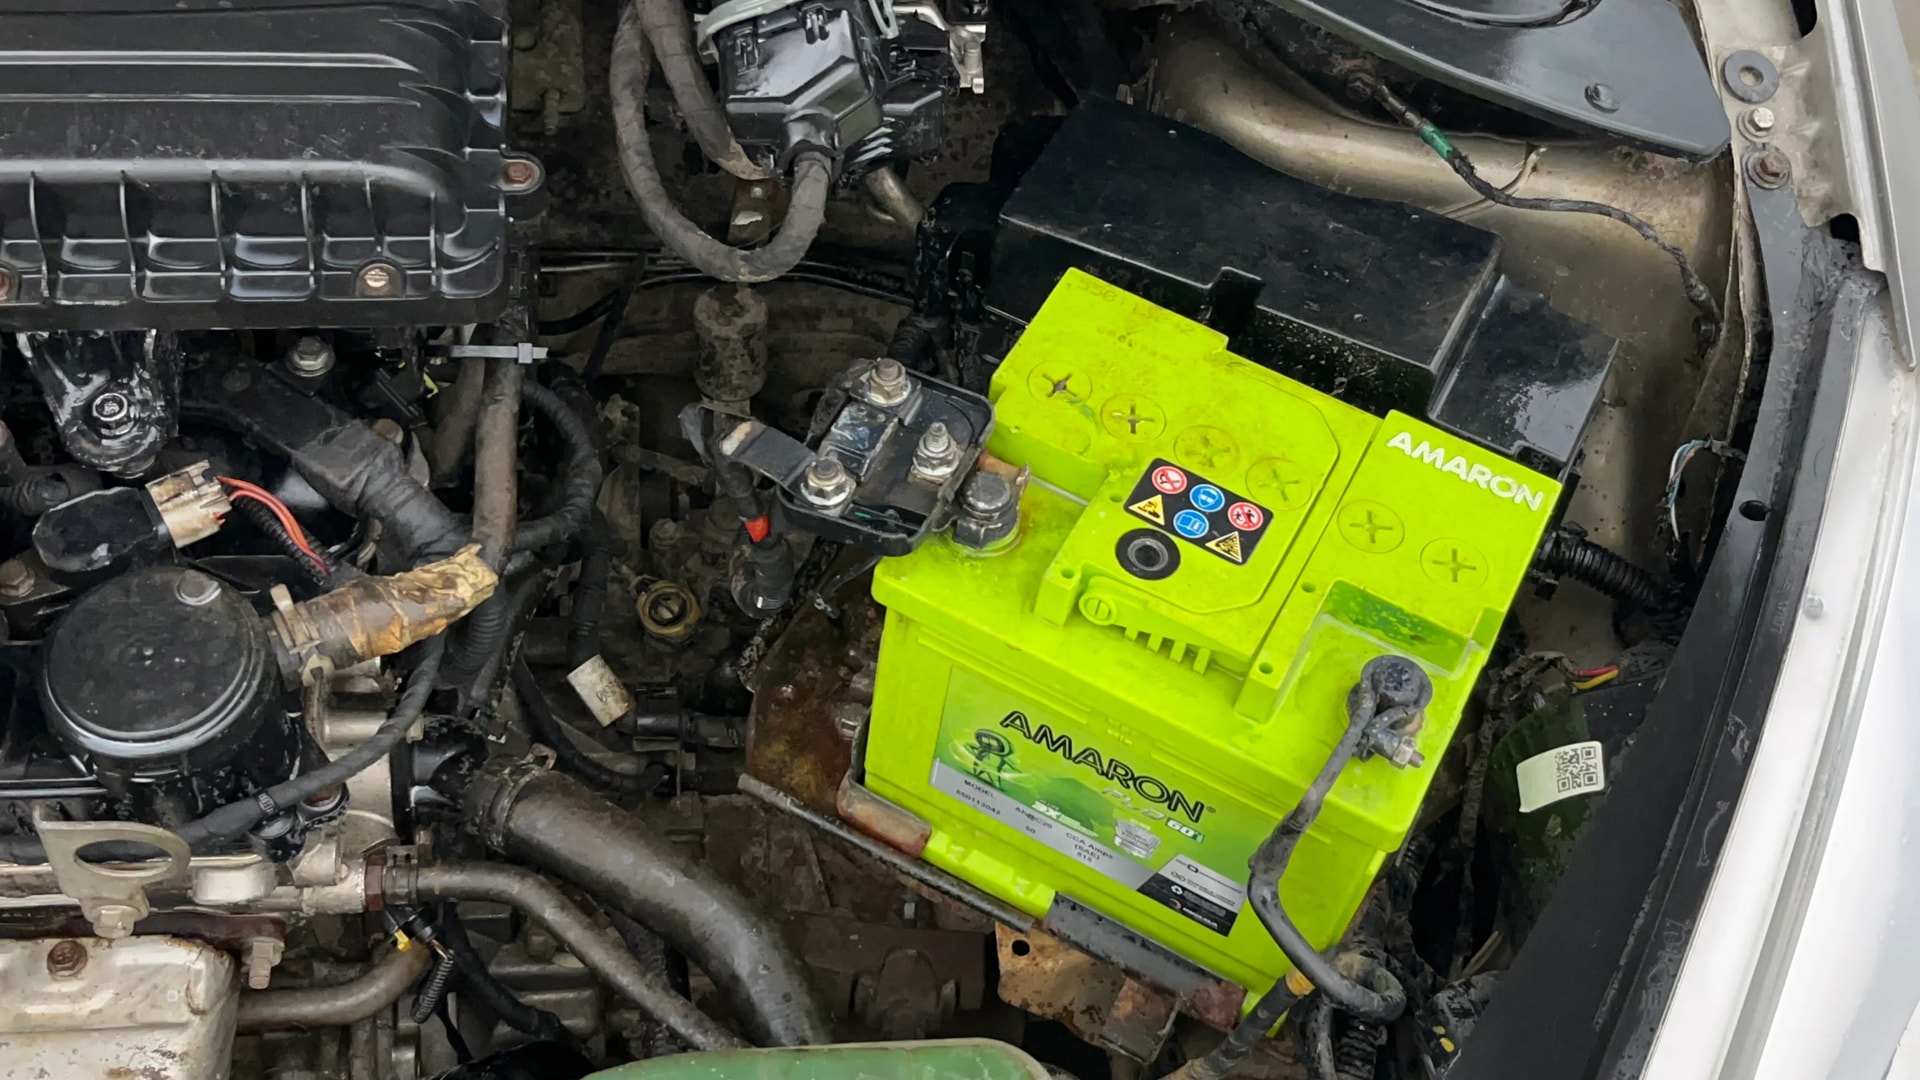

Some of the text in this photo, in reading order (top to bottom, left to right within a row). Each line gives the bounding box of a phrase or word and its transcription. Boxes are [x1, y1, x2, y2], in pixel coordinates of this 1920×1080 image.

[1386, 431, 1543, 511] AMARON
[964, 779, 996, 799] MODEL
[1066, 832, 1086, 845] CCA
[1075, 844, 1101, 860] (SAE)
